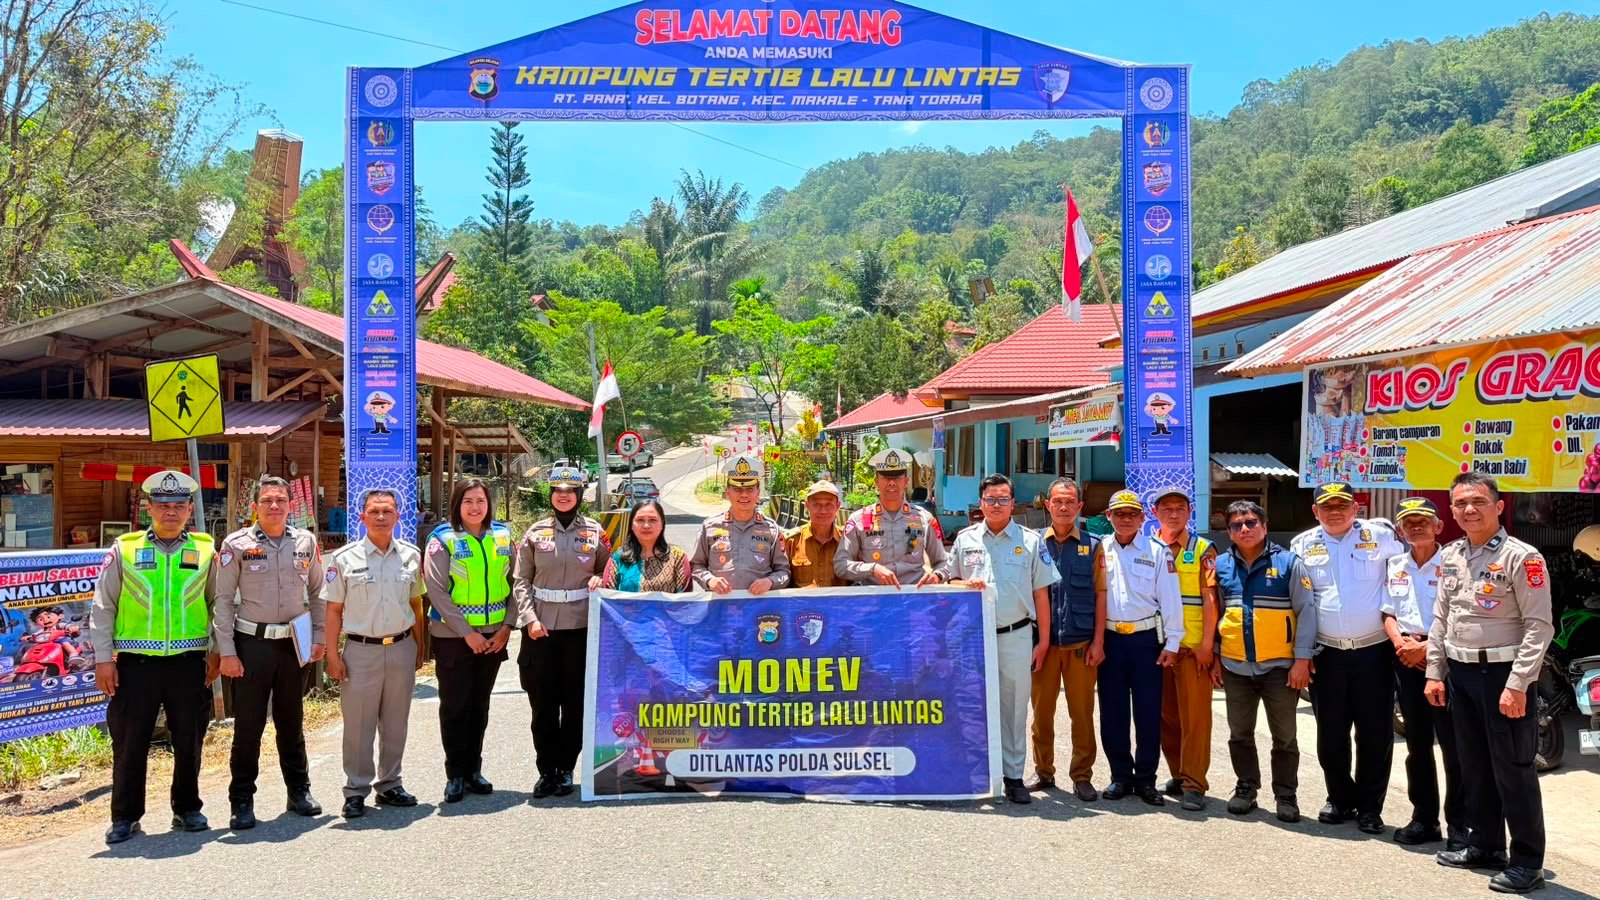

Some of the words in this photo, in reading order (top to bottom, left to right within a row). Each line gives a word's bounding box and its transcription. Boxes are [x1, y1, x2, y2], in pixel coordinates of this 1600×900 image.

[635, 9, 773, 46] SELAMAT
[780, 9, 902, 47] DATANG
[705, 46, 749, 59] ANDA
[753, 46, 833, 59] MEMASUKI
[516, 67, 677, 86] KAMPUNG
[689, 67, 802, 87] TERTIB
[810, 67, 896, 87] LALU
[903, 67, 1021, 86] LINTAS
[554, 94, 578, 104] RT.
[637, 94, 671, 105] KEL.
[676, 94, 739, 105] BOTANG
[751, 94, 787, 105] KEC.
[791, 94, 858, 105] MAKALE
[873, 94, 913, 105] TANA
[919, 94, 983, 105] TORAJA
[1366, 360, 1469, 410] KIOS
[1475, 420, 1513, 435] Bawang
[1565, 414, 1600, 431] Pakan
[1372, 427, 1398, 441] Barang
[1399, 425, 1441, 440] campuran
[1372, 444, 1396, 458] Tomat
[1474, 439, 1503, 455] Rokok
[1369, 461, 1399, 475] Lombok
[1473, 459, 1502, 474] Pakan
[1504, 459, 1527, 475] Babi
[0, 571, 45, 587] BELUM
[1479, 571, 1506, 582] POLRI
[0, 583, 56, 602] NAIK
[35, 597, 57, 605] BAWAH
[718, 657, 861, 694] MONEV
[28, 704, 49, 715] JALAN
[50, 701, 67, 711] RAYA
[68, 697, 84, 707] YANG
[638, 702, 741, 728] KAMPUNG
[747, 701, 815, 727] TERTIB
[820, 701, 867, 727] LALU
[872, 700, 944, 725] LINTAS
[614, 716, 634, 735] STOP
[689, 750, 775, 773] DITLANTAS
[778, 750, 829, 772] POLDA
[832, 750, 892, 772] SULSEL
